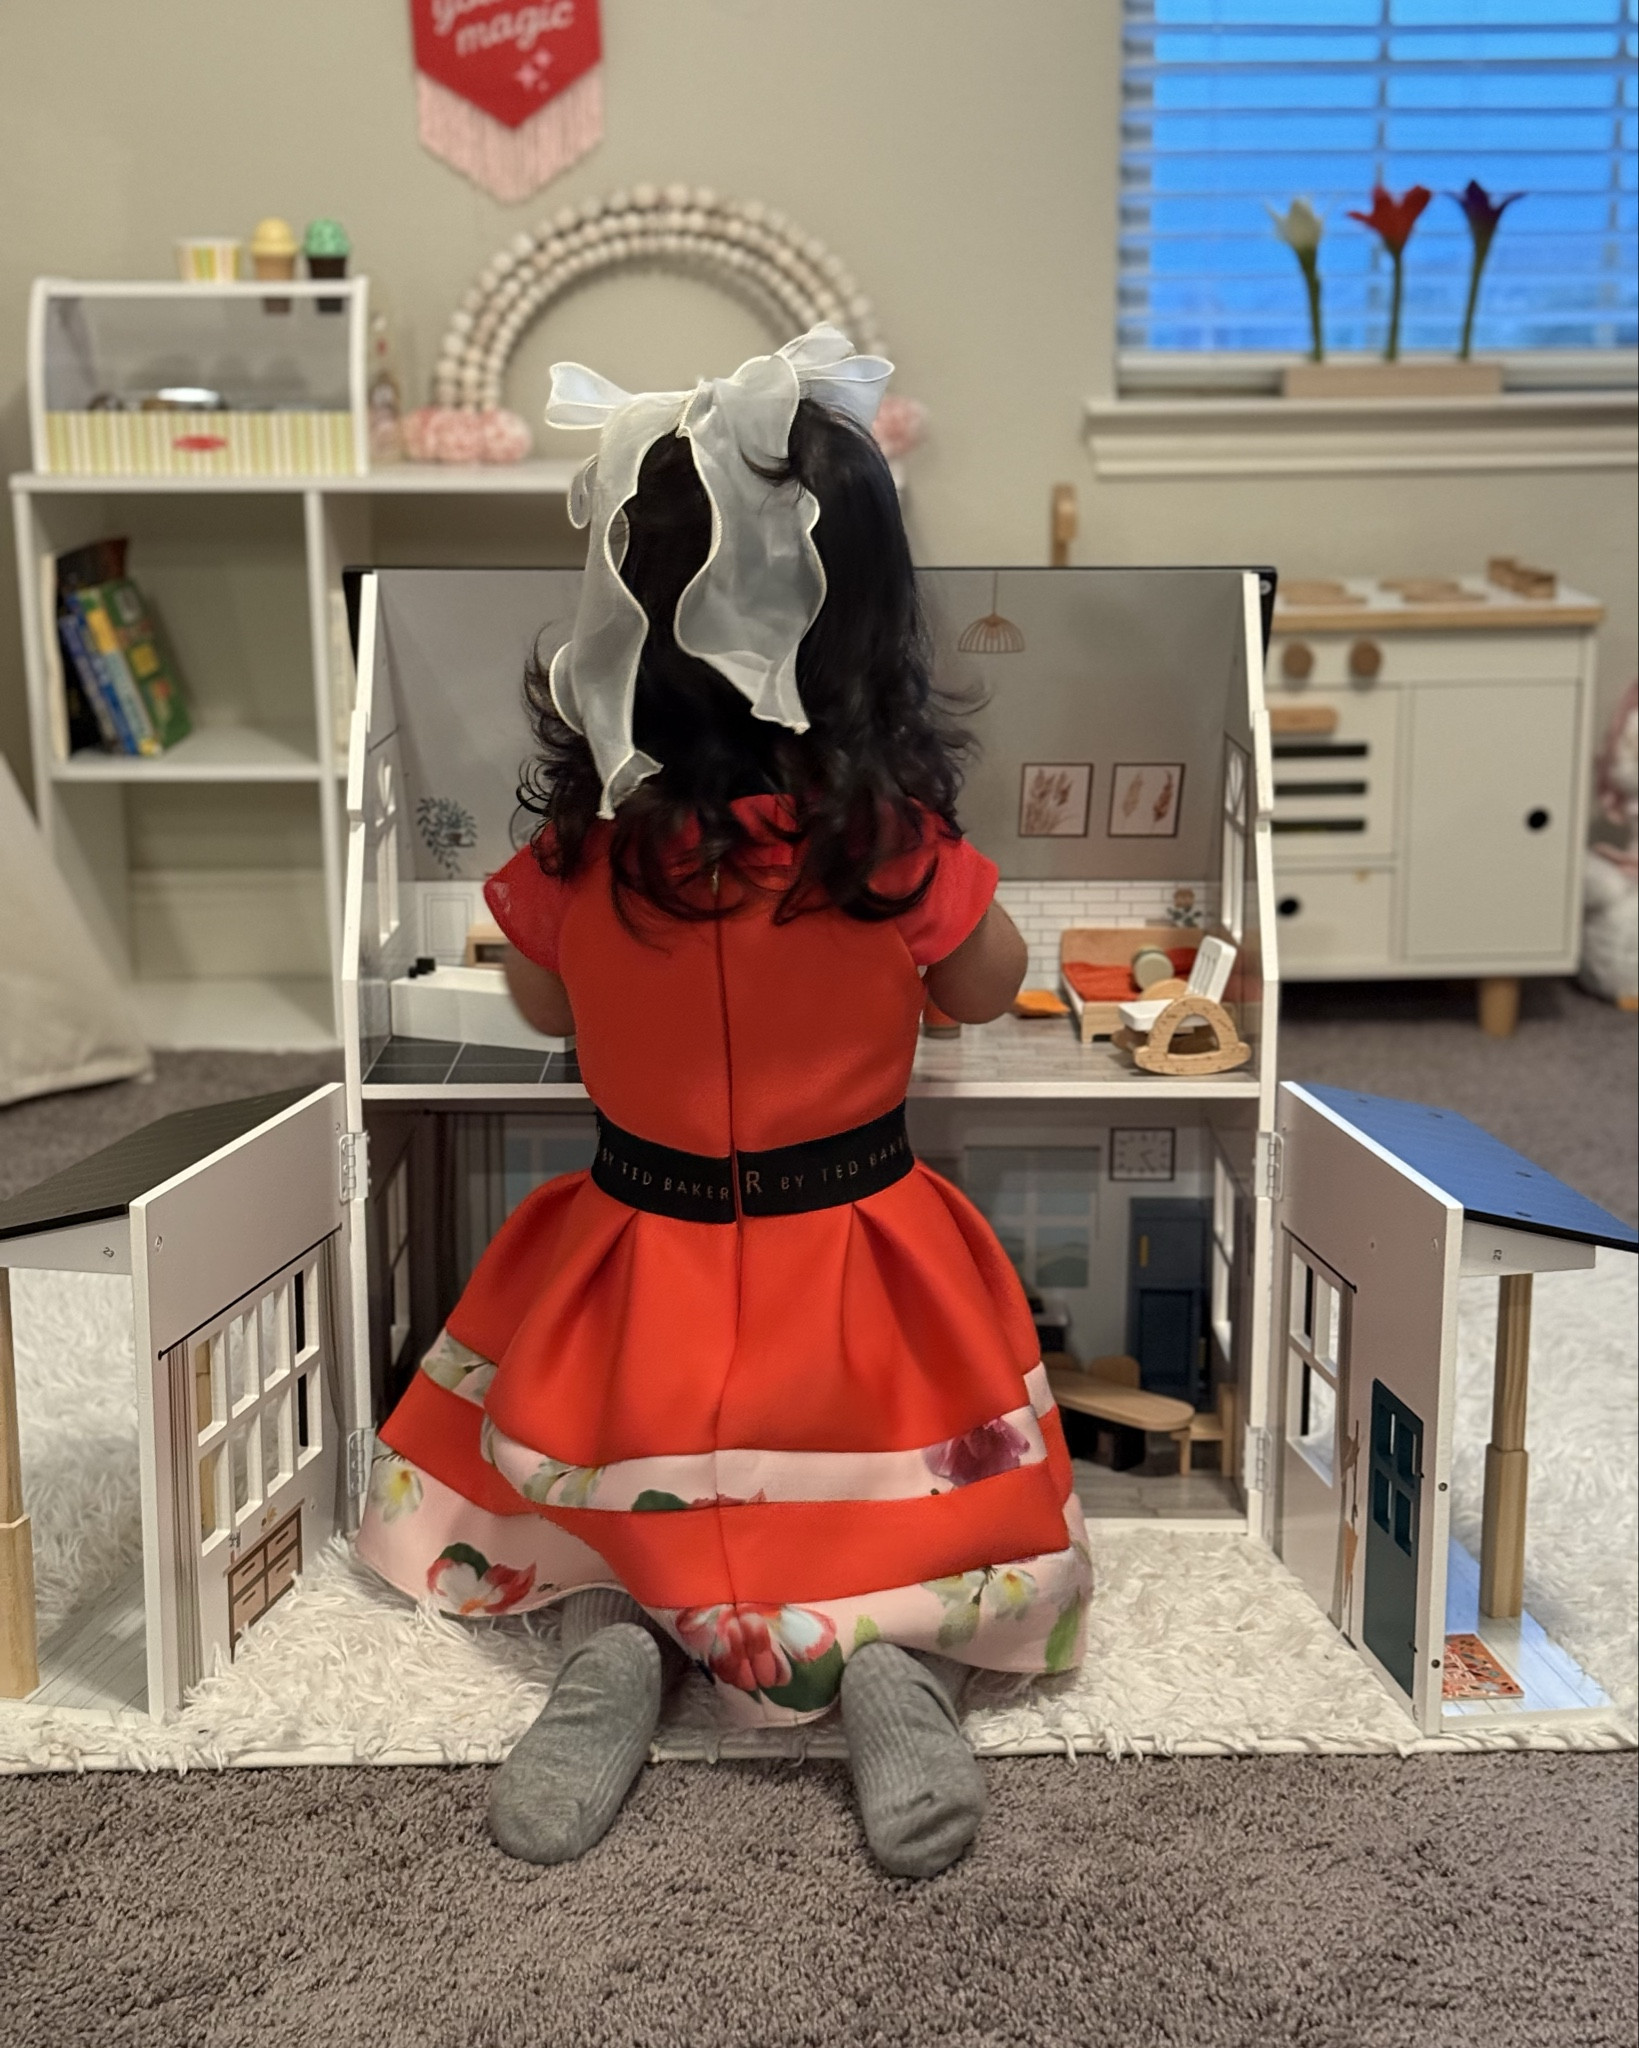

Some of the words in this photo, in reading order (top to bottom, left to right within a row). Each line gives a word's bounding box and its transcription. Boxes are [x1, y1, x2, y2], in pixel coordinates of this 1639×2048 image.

[455, 0, 574, 56] magic
[622, 1161, 653, 1185] TED
[664, 1177, 730, 1200] BAKER
[780, 1174, 805, 1190] BY
[822, 1160, 859, 1182] TED
[103, 1246, 115, 1258] 23
[1493, 1249, 1503, 1261] 23
